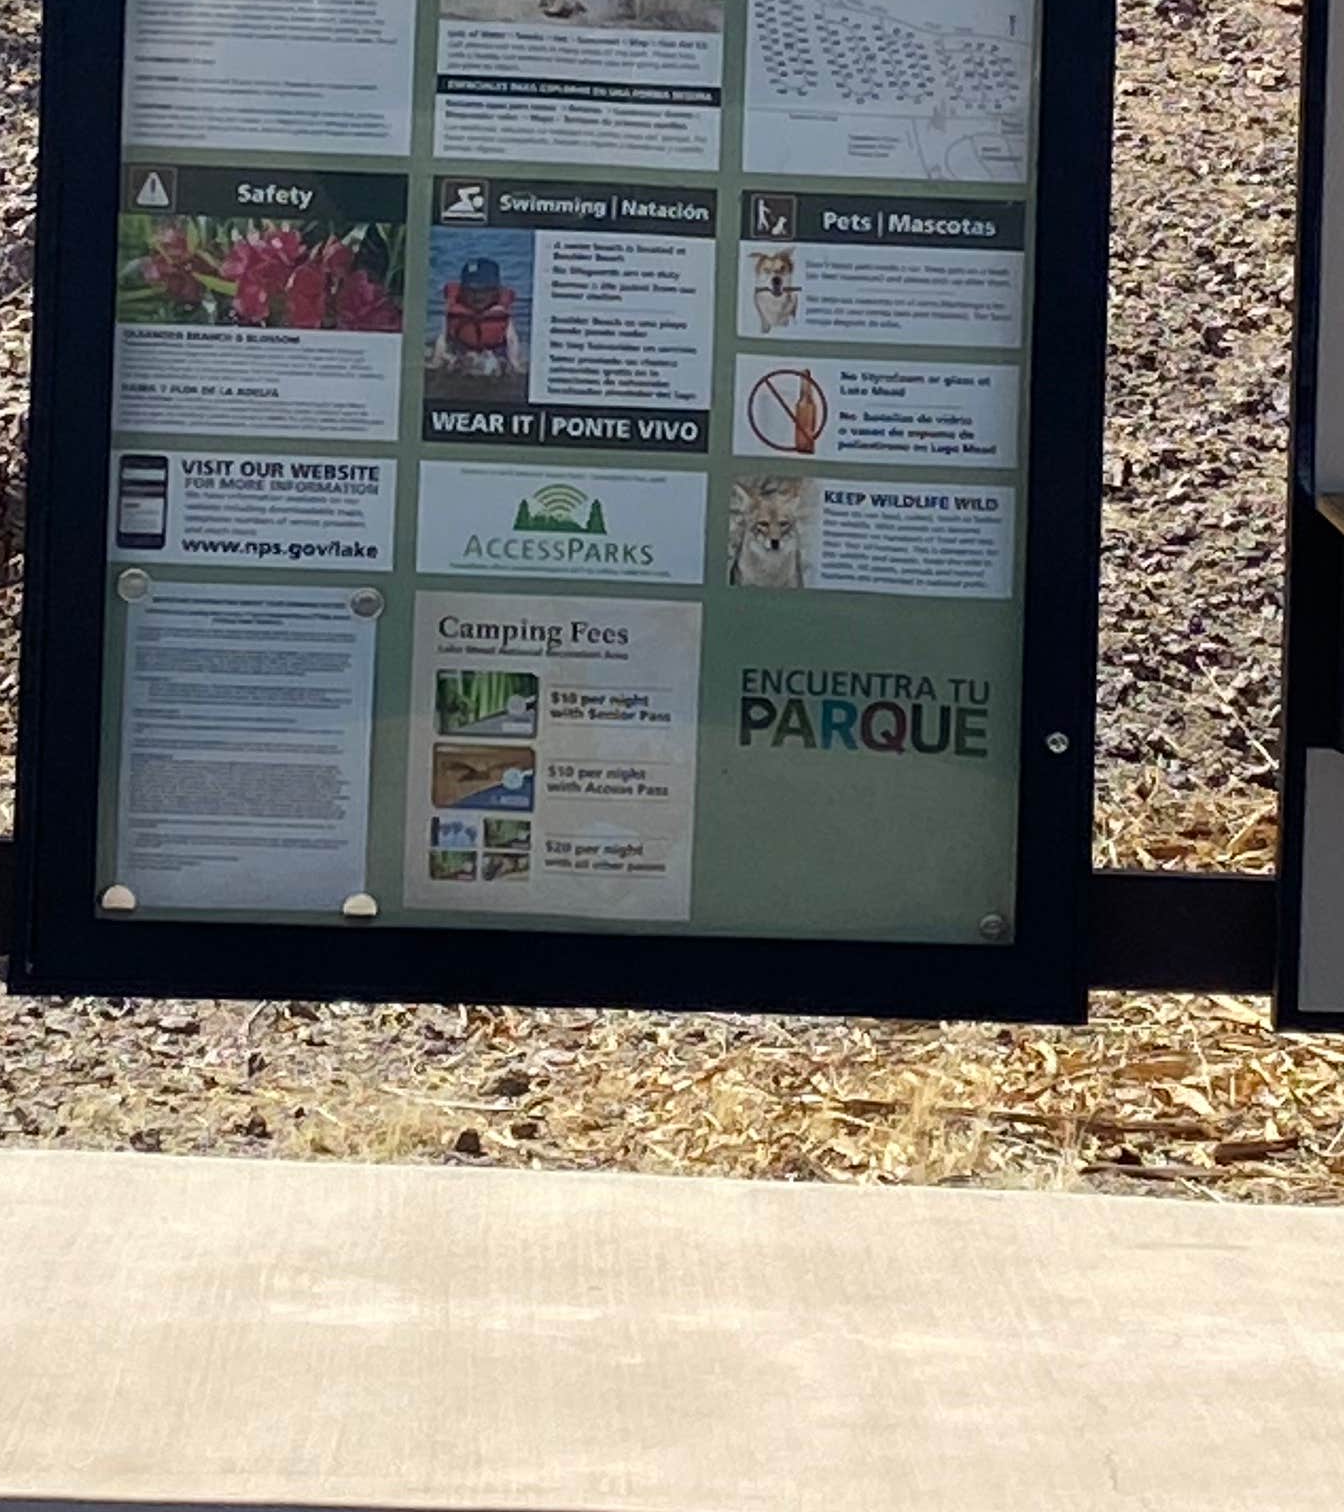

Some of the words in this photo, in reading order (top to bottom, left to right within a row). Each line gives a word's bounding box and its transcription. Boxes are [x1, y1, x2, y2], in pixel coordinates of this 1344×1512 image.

[237, 184, 313, 209] Safety
[500, 194, 606, 220] Swimming
[621, 199, 710, 220] Natación
[823, 211, 872, 232] Pets
[888, 214, 996, 236] Mascotas
[432, 411, 504, 433] WEAR
[513, 414, 534, 434] IT
[552, 416, 631, 438] PONTE
[638, 420, 698, 440] VIVO
[182, 460, 235, 476] VISIT
[240, 461, 284, 478] OUR
[291, 463, 380, 482] WEBSITE
[185, 477, 216, 488] FOR
[219, 478, 266, 490] MORE
[270, 480, 379, 496] INFORMATION
[824, 490, 865, 506] KEEP
[871, 494, 950, 510] WILDLIFE
[954, 496, 999, 511] WILD
[182, 538, 378, 560] www.nps.gov/lake
[438, 615, 562, 647] Camping
[570, 620, 629, 645] Fees
[742, 668, 937, 701] ENCUENTRA
[948, 678, 990, 705] TU
[739, 696, 989, 758] PARQUE
